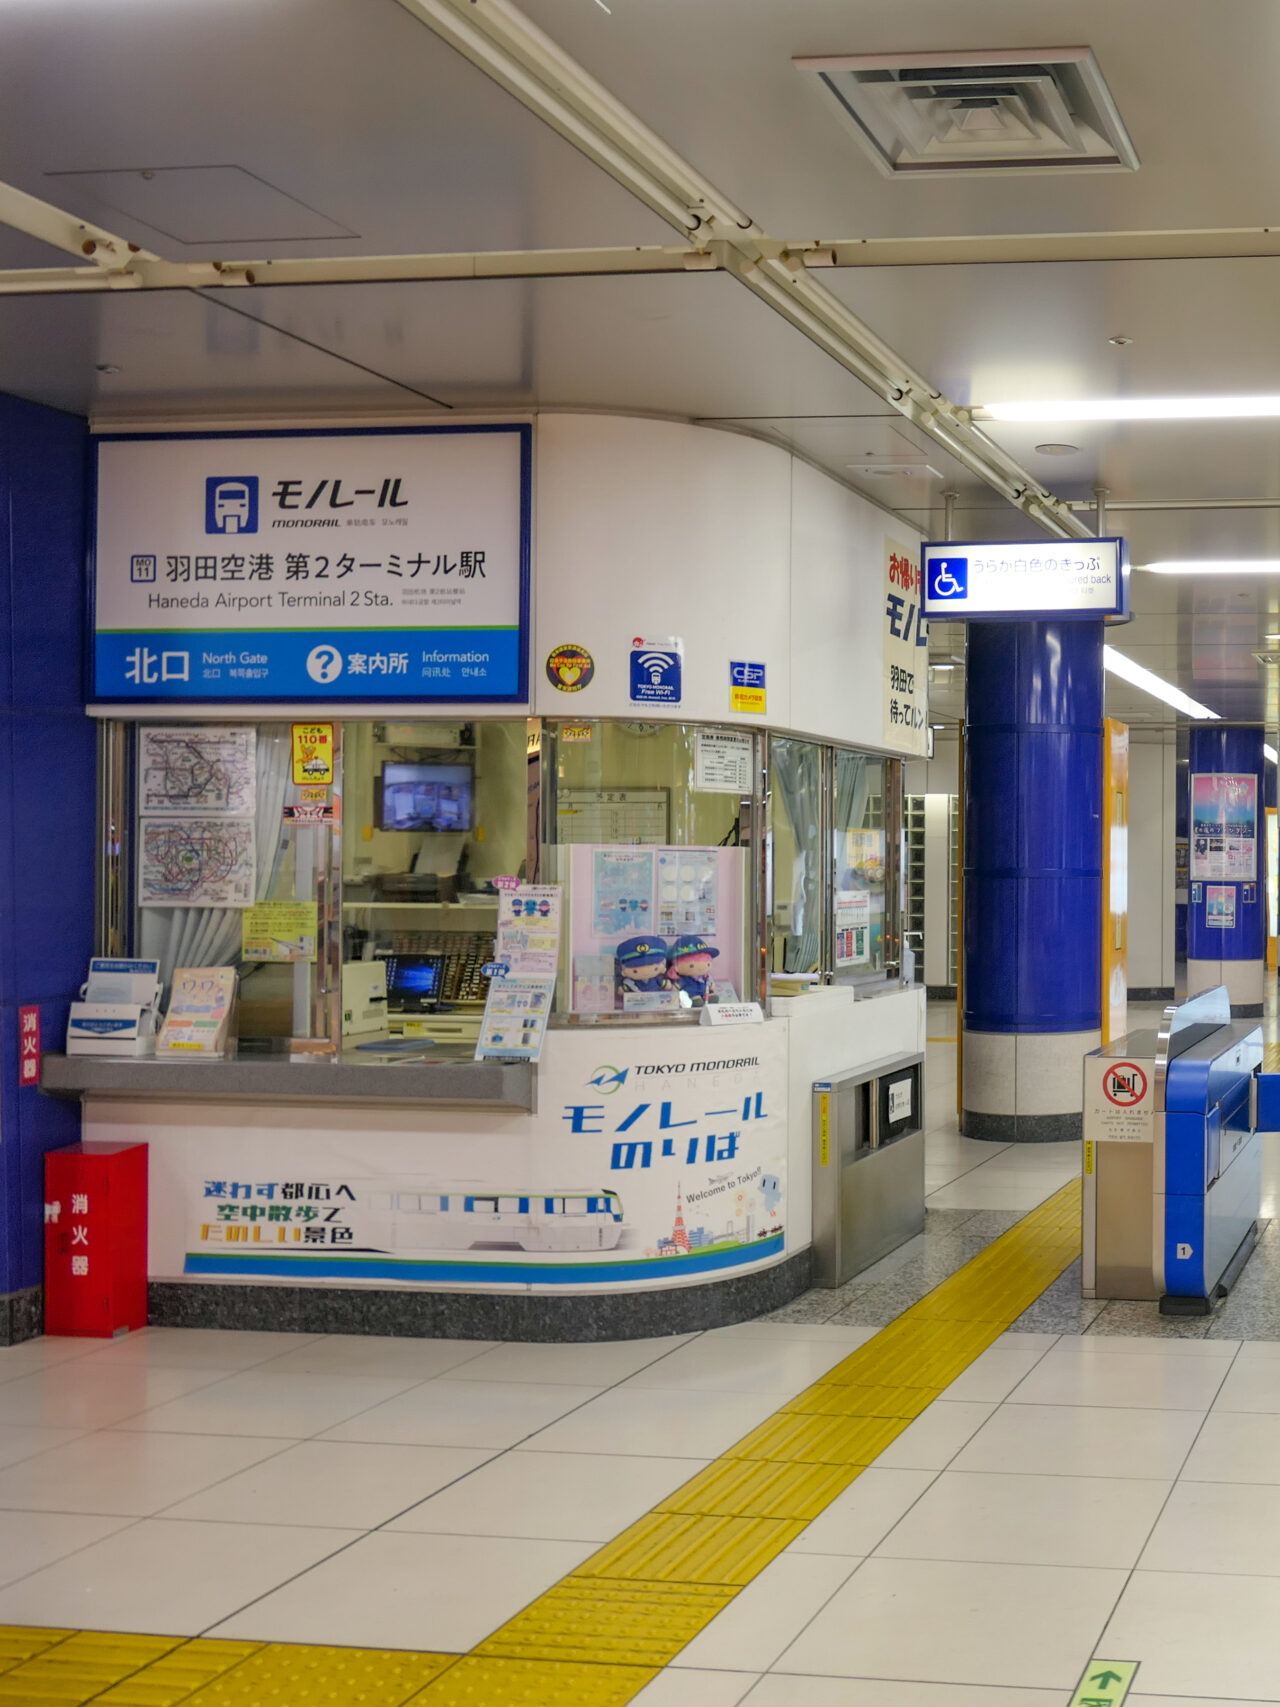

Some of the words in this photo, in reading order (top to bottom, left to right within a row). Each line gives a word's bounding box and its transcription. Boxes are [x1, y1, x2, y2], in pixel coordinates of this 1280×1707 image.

[271, 478, 409, 509] モノレール
[271, 518, 341, 528] MONORAIL
[136, 567, 150, 577] 11
[166, 554, 274, 582] 羽田空港
[285, 551, 486, 580] 第2ターミナル駅
[1091, 574, 1112, 584] back
[148, 592, 209, 608] Haneda
[215, 592, 273, 612] Airport
[279, 591, 346, 607] Terminal
[350, 591, 361, 606] 2
[364, 591, 393, 607] Sta.
[125, 648, 190, 684] 北口
[202, 652, 236, 664] North
[239, 652, 268, 664] Gate
[347, 653, 409, 675] 案内所
[422, 650, 490, 663] Information
[891, 665, 914, 694] 羽田で
[24, 1013, 36, 1079] 消火器
[635, 1063, 686, 1075] TOKYO
[689, 1056, 760, 1072] MONORAIL
[562, 1092, 769, 1133] モノレール
[610, 1131, 741, 1170] のりば
[686, 1184, 726, 1204] Welcome
[727, 1180, 736, 1189] to
[71, 1193, 89, 1276] 消火器
[200, 1223, 354, 1245] たのしい景色
[1181, 1246, 1186, 1255] 1
